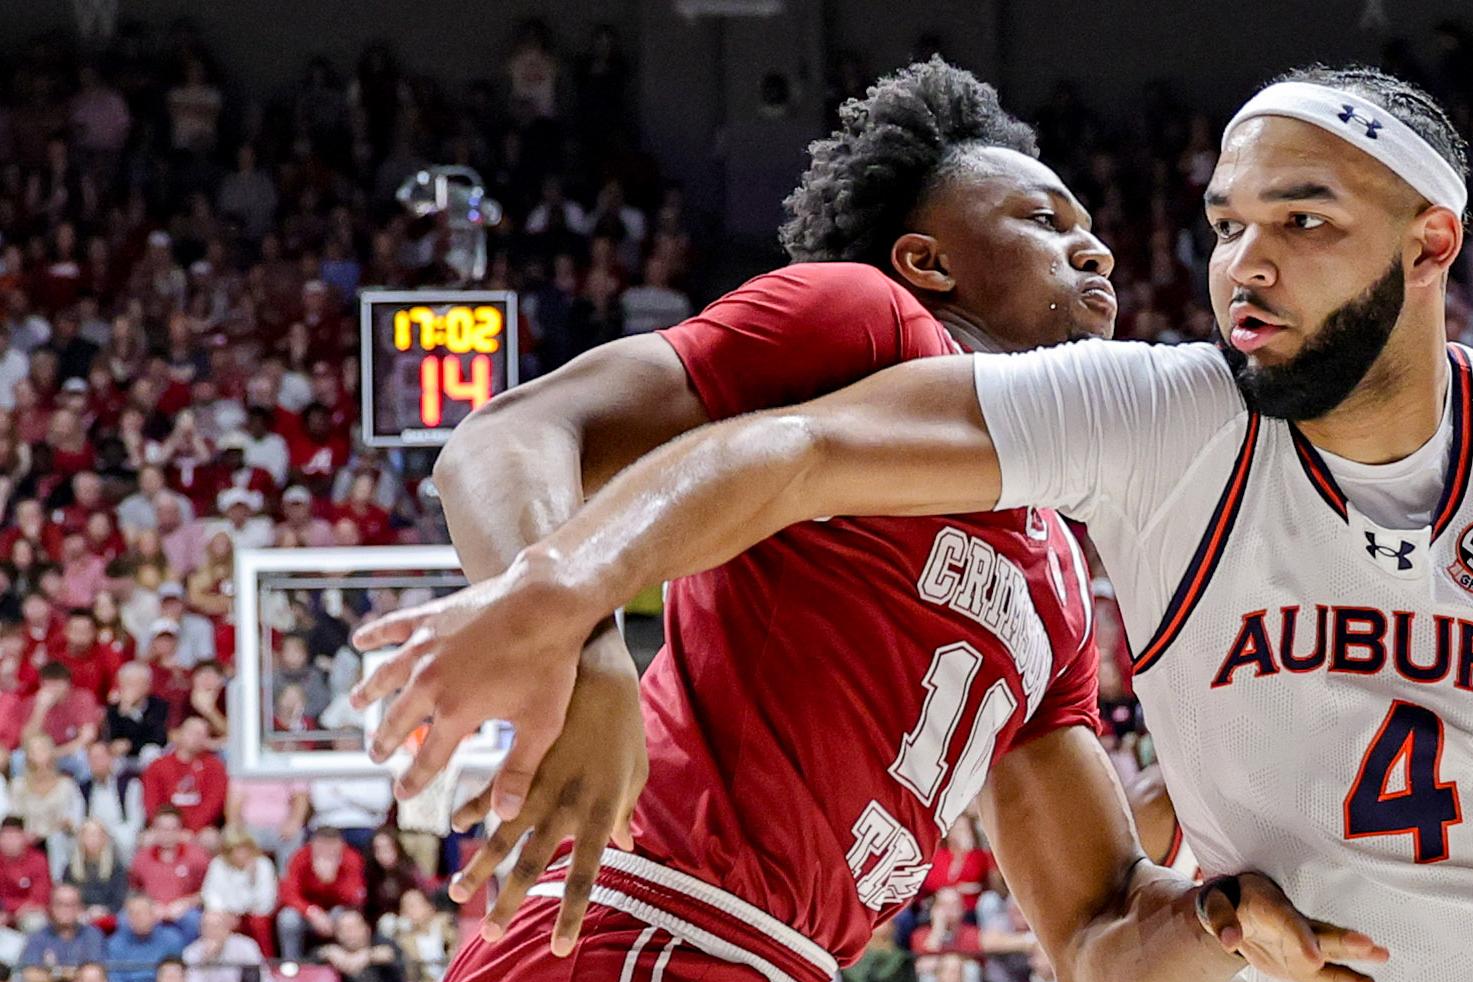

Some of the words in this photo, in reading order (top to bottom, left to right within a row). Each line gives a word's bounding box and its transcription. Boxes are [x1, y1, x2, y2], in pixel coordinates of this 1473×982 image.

[394, 306, 503, 353] 17:02
[420, 354, 492, 427] 14
[1343, 698, 1464, 865] 4
